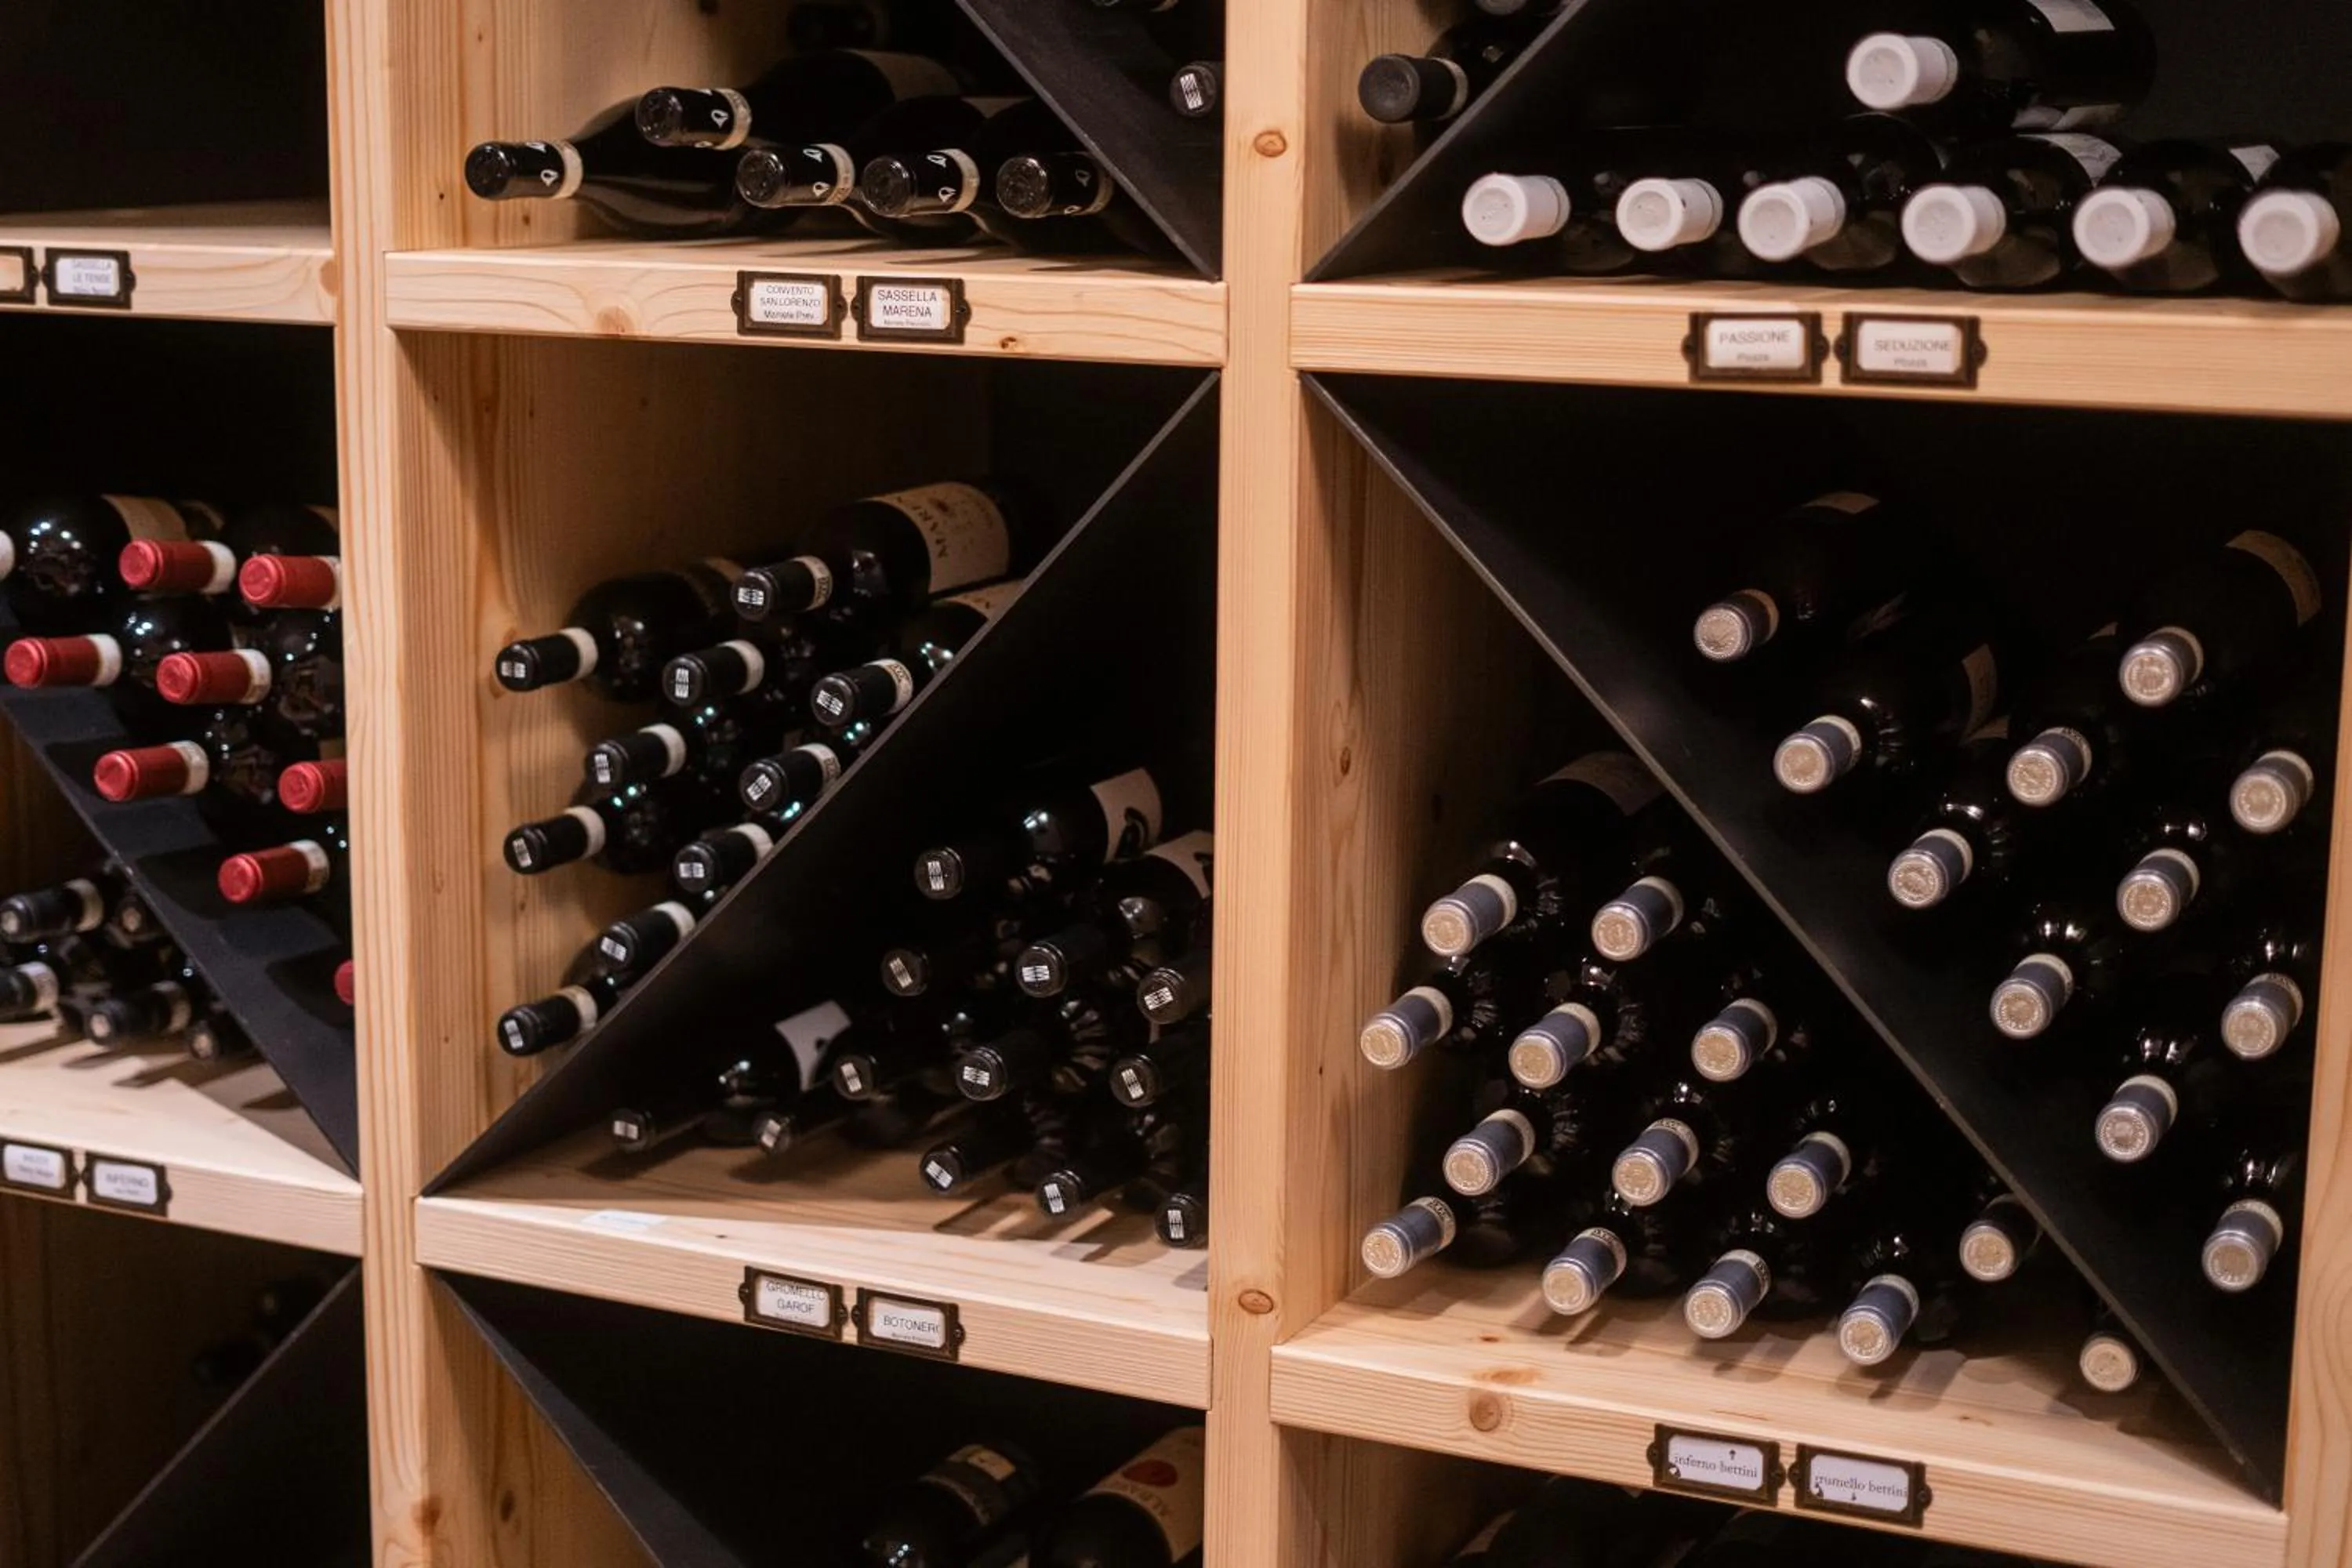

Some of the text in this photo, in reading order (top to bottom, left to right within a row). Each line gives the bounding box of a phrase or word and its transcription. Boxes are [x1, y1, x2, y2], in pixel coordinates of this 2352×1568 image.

[765, 285, 814, 295] CONVENTO
[877, 289, 937, 302] SASSELLA
[883, 304, 932, 318] MARENA
[1719, 329, 1791, 344] PASSIONE
[1874, 338, 1952, 352] SEDUZIONE
[1674, 1454, 1758, 1478] inferno bettini
